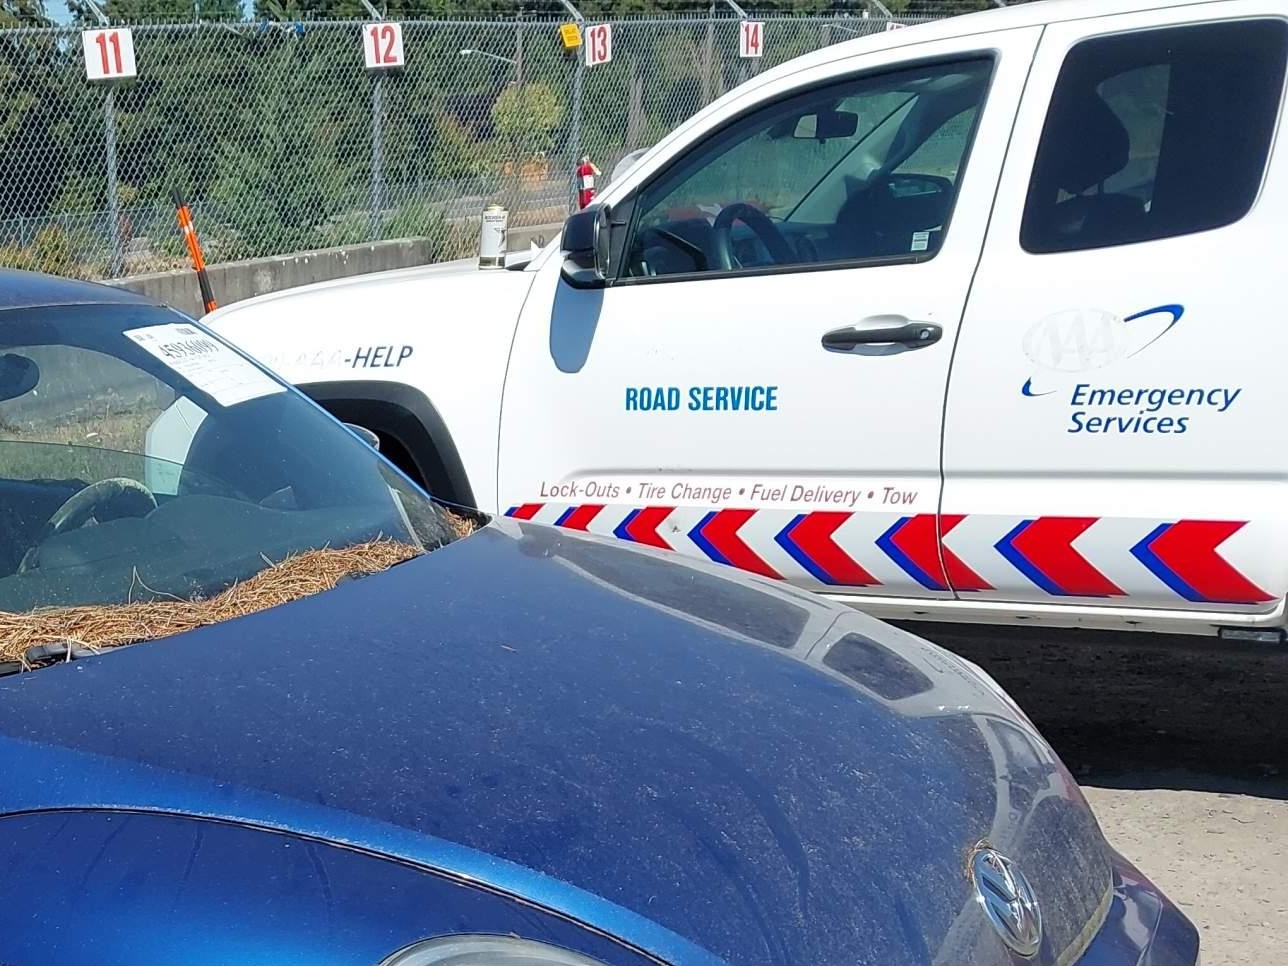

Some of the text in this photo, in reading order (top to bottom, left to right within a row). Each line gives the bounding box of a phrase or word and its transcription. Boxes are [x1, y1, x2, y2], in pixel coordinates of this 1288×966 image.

[95, 31, 123, 75] 11
[370, 25, 398, 64] 12
[590, 26, 607, 62] 13
[745, 24, 760, 55] 14
[626, 386, 777, 411] ROAD SERVICE
[1070, 383, 1242, 413] Emergency
[1067, 410, 1189, 434] Services
[540, 481, 918, 507] Lock-Outs Tire Change Fuel Delivery Tow
